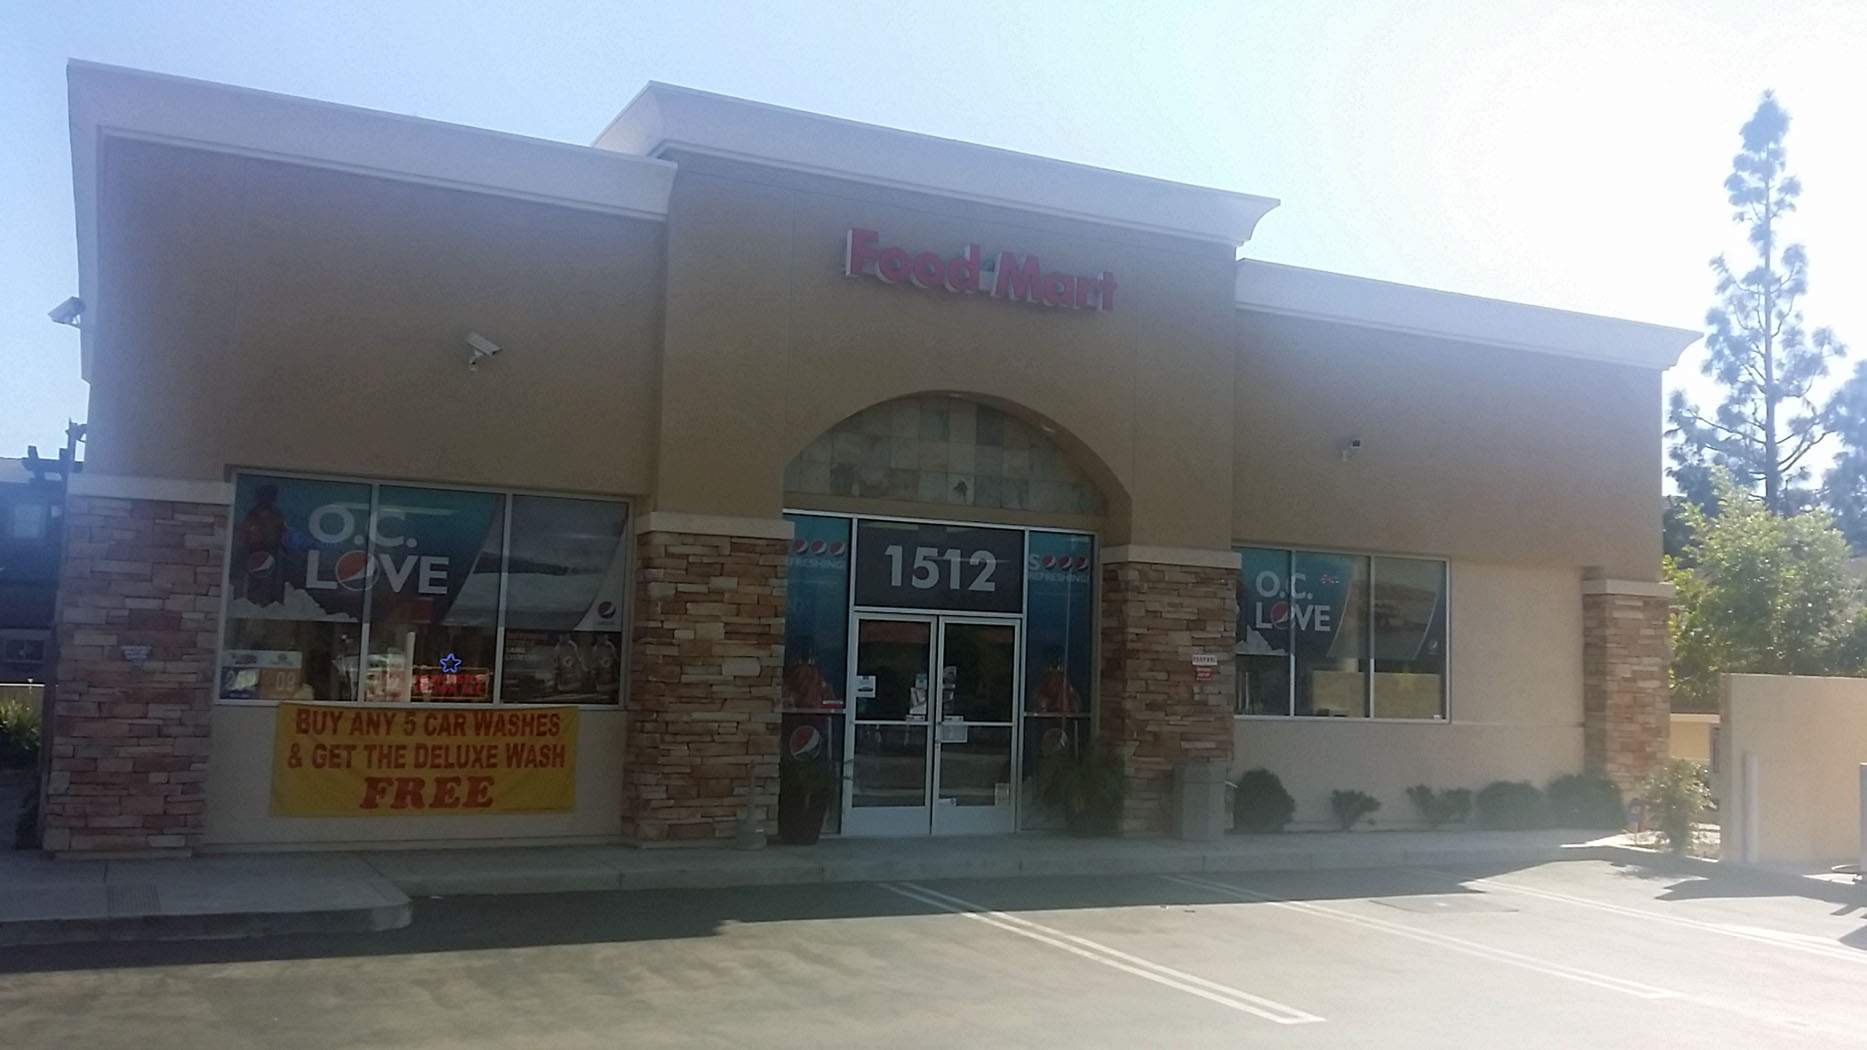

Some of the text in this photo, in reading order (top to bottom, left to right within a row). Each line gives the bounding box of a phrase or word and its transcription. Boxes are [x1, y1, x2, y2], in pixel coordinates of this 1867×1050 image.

[845, 228, 1118, 312] Food Mart
[308, 504, 418, 548] O.C.
[306, 550, 450, 595] LOVE
[884, 545, 997, 592] 1512
[1256, 570, 1313, 599] O.C.
[1255, 601, 1331, 632] LOVE
[295, 709, 561, 737] BUY ANY 5 CAR WASHES
[287, 743, 566, 769] & GET THE DELUXE WASH
[359, 776, 495, 809] FREE
